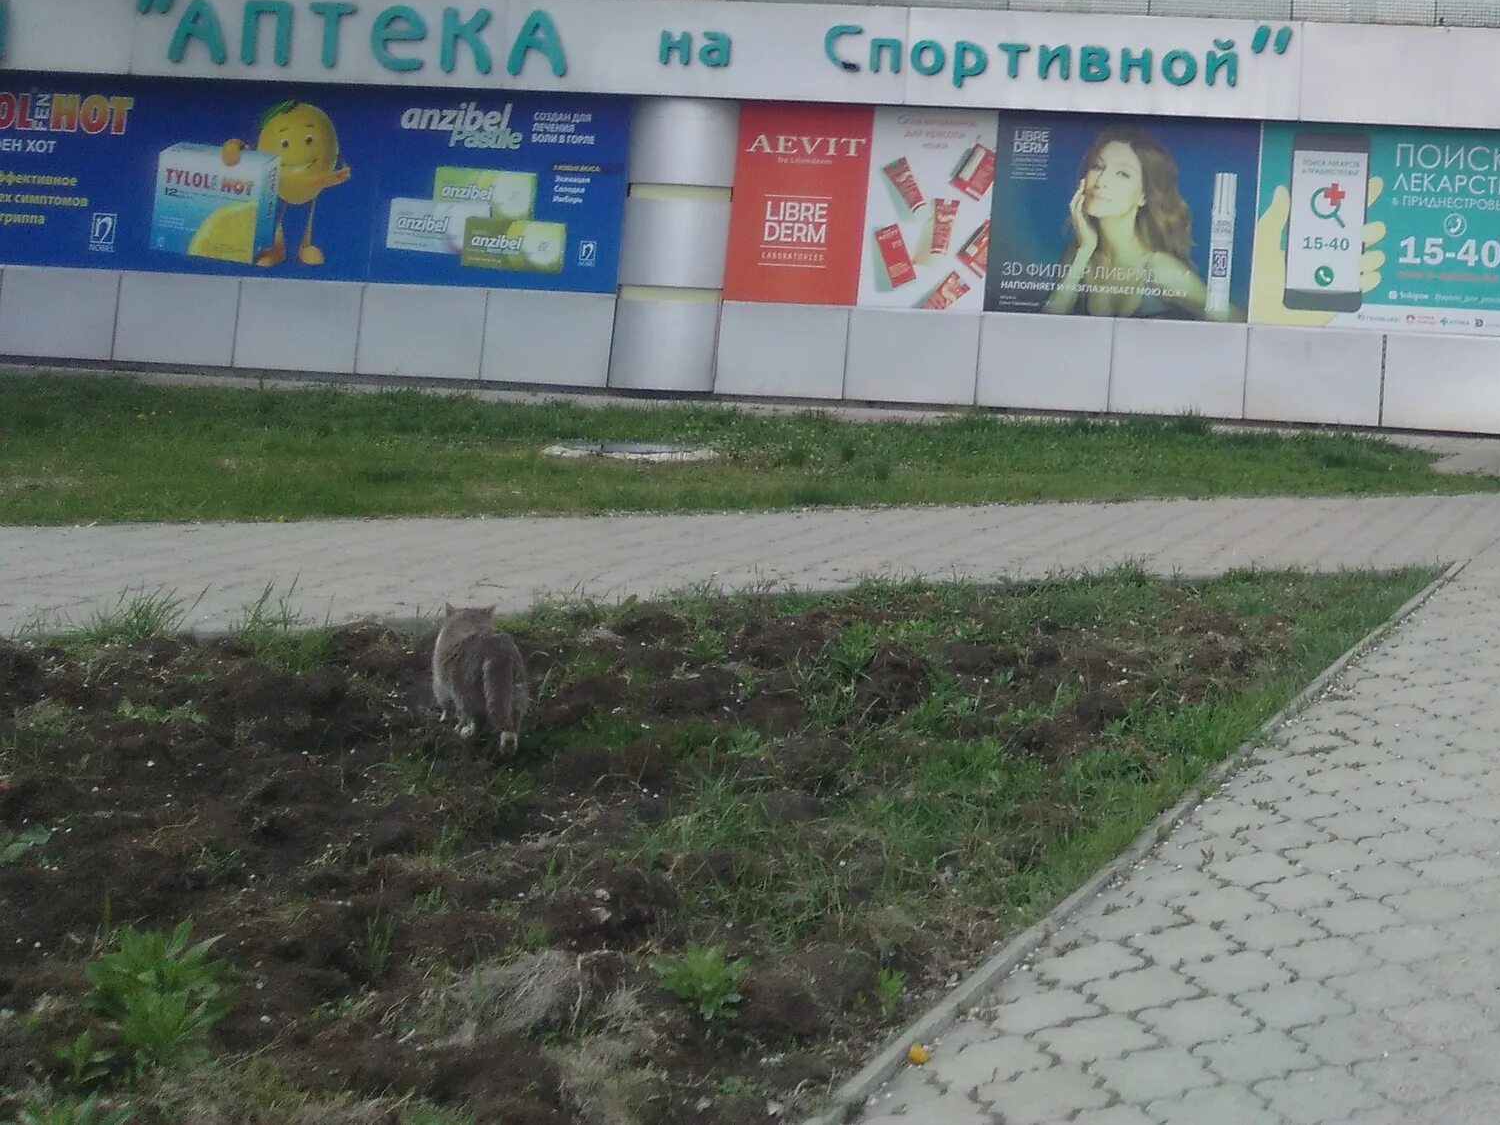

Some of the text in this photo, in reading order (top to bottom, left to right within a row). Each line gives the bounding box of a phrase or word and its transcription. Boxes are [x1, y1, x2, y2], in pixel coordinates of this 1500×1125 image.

[658, 29, 733, 68] на
[51, 93, 134, 135] HOT
[401, 102, 513, 132] anzibel
[533, 111, 570, 122] СОЗДАН
[532, 123, 575, 133] ЛЕЧЕНИЯ
[1014, 130, 1050, 142] LIBRE
[26, 141, 57, 154] ХОТ
[531, 134, 557, 144] БОЛИ
[566, 135, 595, 145] ГОРЛЕ
[746, 134, 866, 157] AEVIT
[1013, 141, 1049, 154] DERM
[166, 168, 209, 189] TYLOL
[15, 194, 88, 207] симптомов
[441, 184, 493, 201] anzibel
[766, 201, 828, 223] LIBRE
[397, 214, 449, 233] anzibel
[764, 222, 826, 244] DERM
[471, 234, 523, 251] anzibel
[1302, 236, 1350, 252] 15-40
[761, 251, 825, 262] LABORATORIES
[1002, 261, 1023, 277] 3D
[1000, 280, 1056, 291] НАПОЛНЯЕТ
